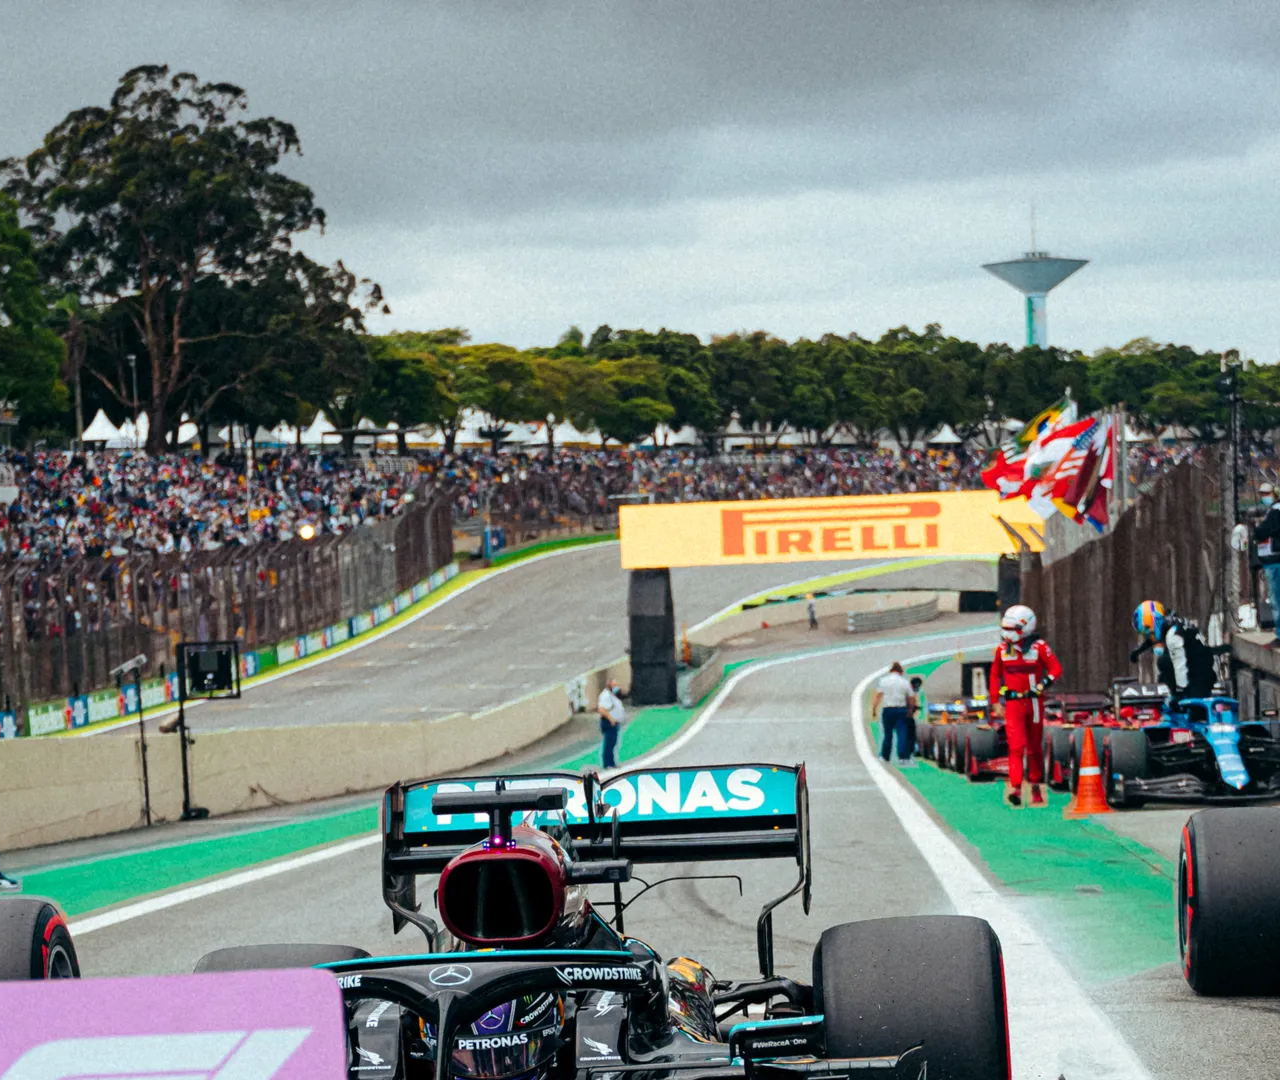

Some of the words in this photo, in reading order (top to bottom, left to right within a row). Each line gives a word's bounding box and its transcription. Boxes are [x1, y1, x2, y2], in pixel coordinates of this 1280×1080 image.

[721, 501, 941, 556] PIRELLI
[564, 967, 643, 981] CROWDSTRIKE
[458, 1033, 529, 1050] PETRONAS
[752, 1038, 807, 1049] #WeRaceAOne
